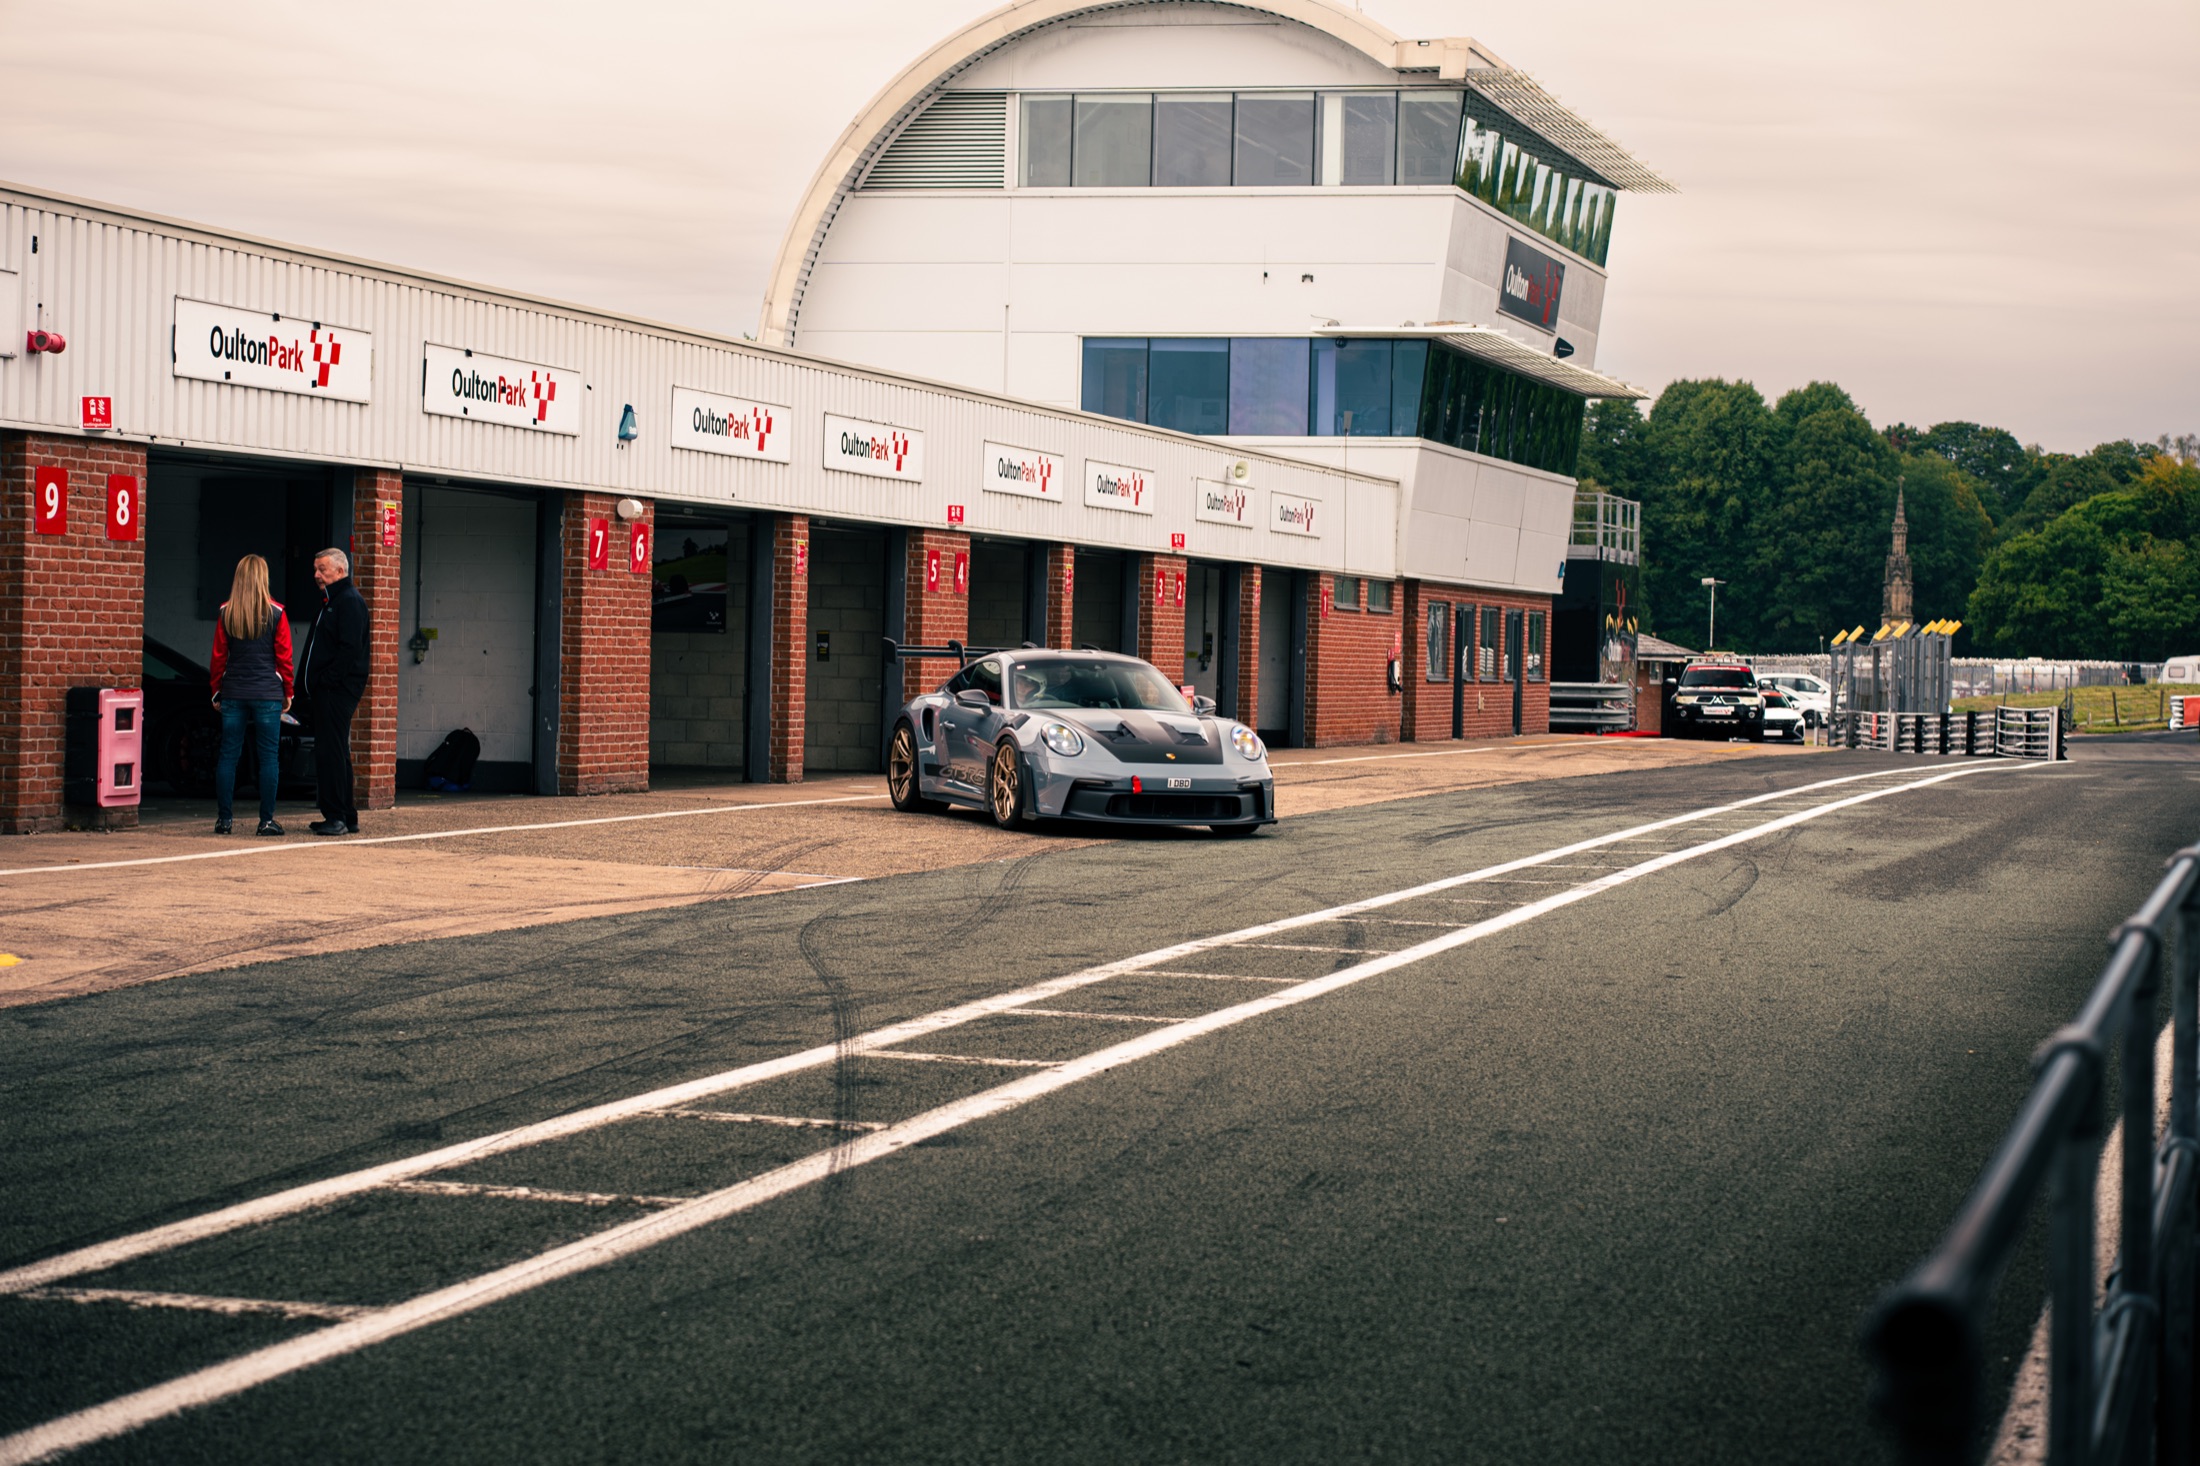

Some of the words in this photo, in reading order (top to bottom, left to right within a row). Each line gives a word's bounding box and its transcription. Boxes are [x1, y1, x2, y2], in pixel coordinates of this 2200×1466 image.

[210, 325, 304, 373] OultonPark
[452, 368, 527, 408] OultonPark
[693, 407, 750, 440] OultonPark
[841, 431, 889, 461] OultonPark
[998, 457, 1036, 483] OultonPark
[1097, 474, 1131, 498] OultonPark
[45, 482, 59, 520] 9
[116, 489, 130, 526] 8
[595, 529, 604, 558] 7
[635, 533, 645, 562] 6
[930, 558, 938, 583] 5
[957, 562, 964, 585] 4
[1158, 577, 1164, 599] 3
[1177, 580, 1183, 600] 2
